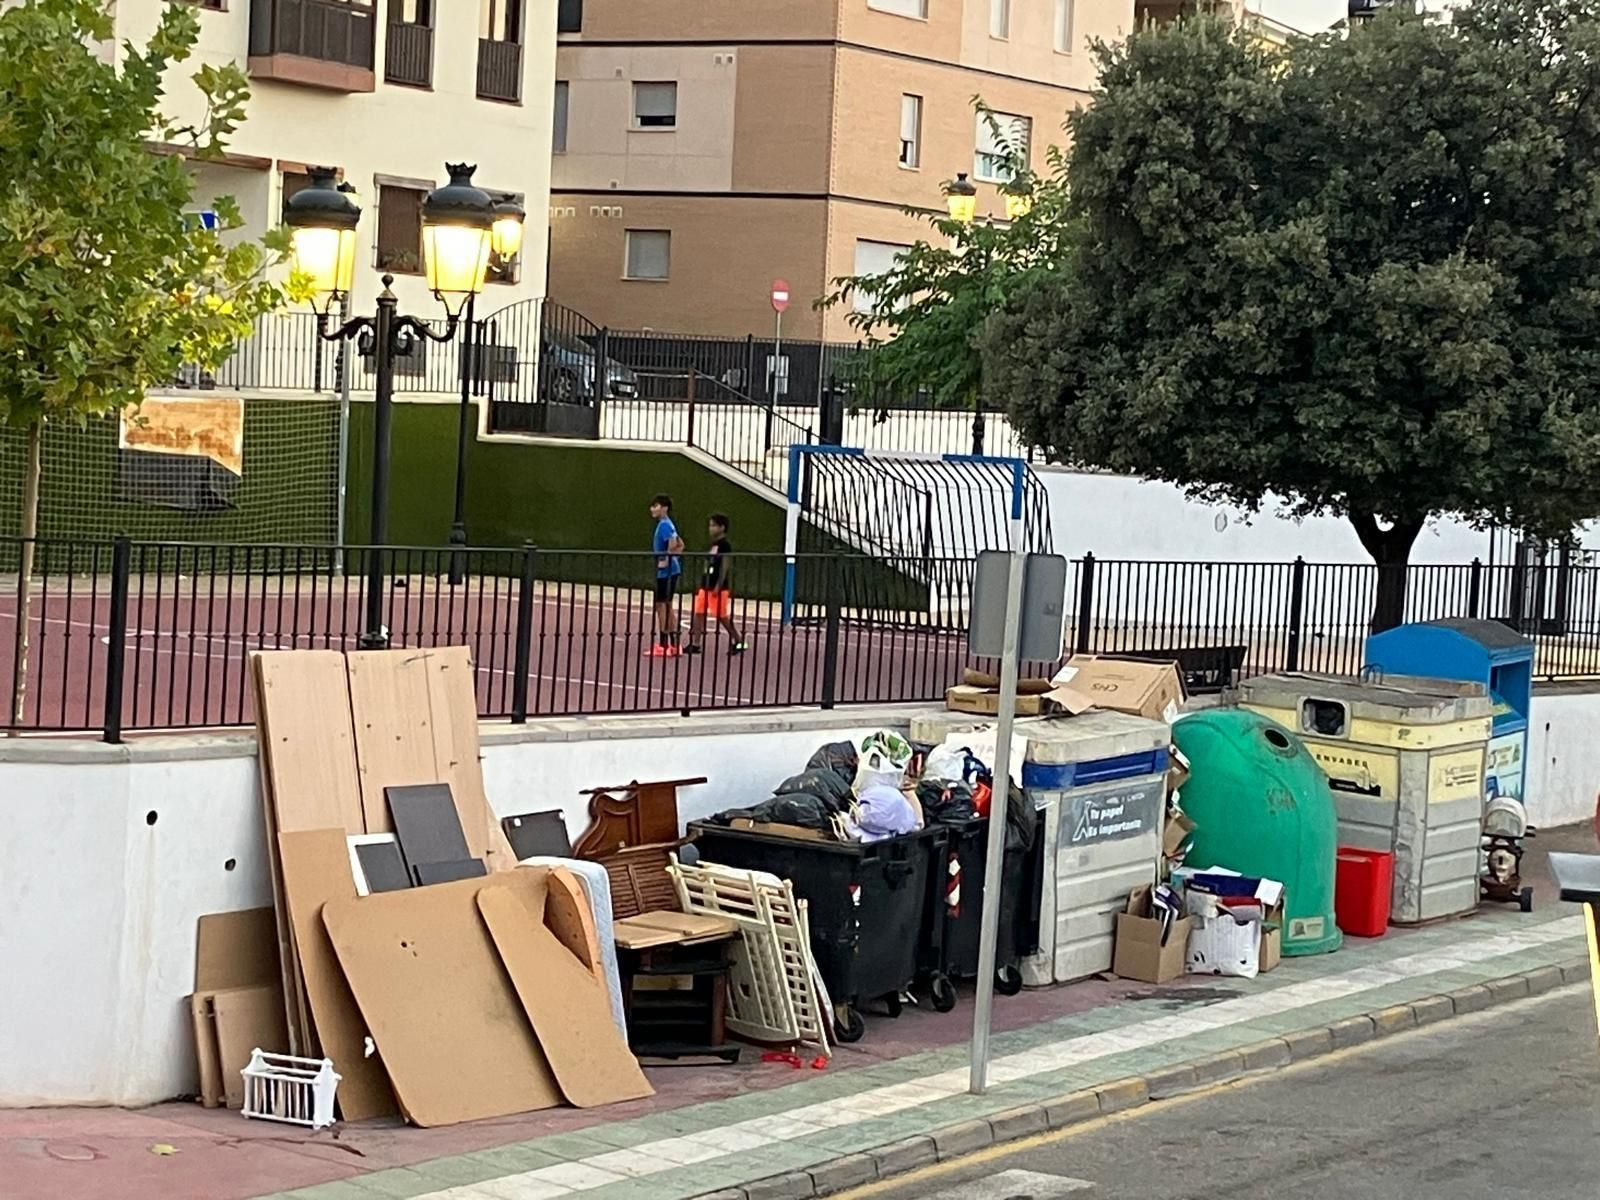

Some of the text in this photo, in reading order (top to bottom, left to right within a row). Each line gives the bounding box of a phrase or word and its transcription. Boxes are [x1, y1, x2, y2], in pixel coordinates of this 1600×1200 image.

[1090, 804, 1124, 820] Tu papel
[1099, 819, 1142, 835] importante
